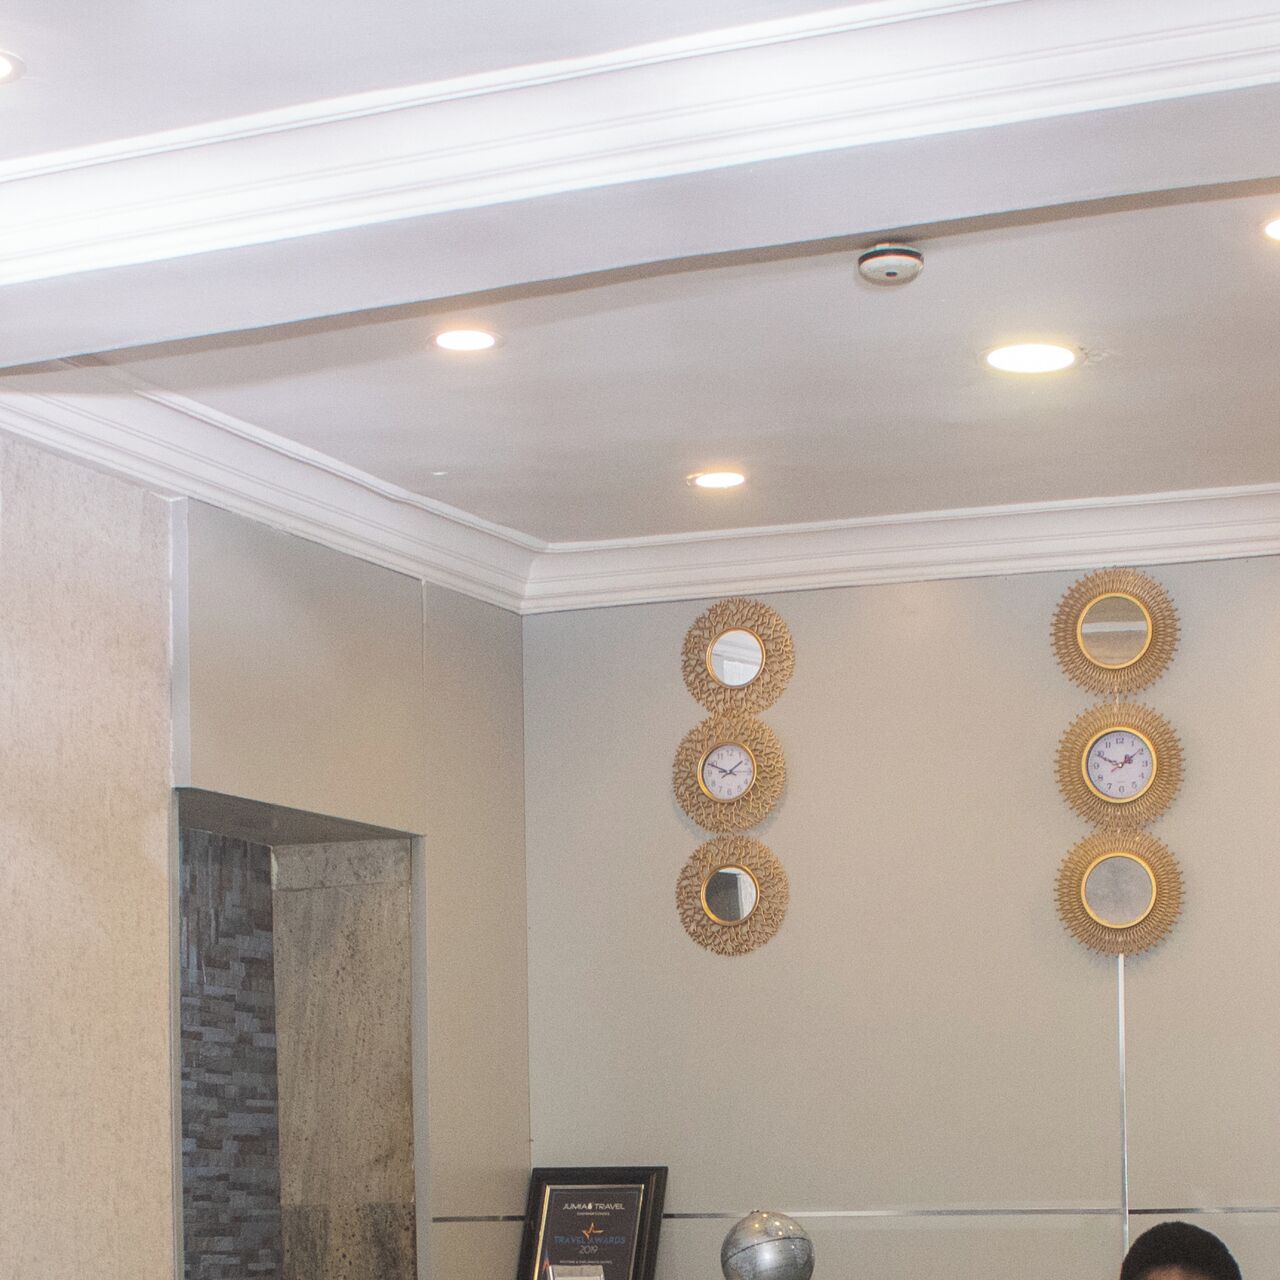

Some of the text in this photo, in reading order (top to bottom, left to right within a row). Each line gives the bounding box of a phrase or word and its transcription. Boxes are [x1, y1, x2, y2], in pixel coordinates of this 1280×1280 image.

[1106, 741, 1111, 749] 11
[554, 1235, 626, 1245] TRAVEL AWARDS
[578, 1245, 599, 1254] 2019
